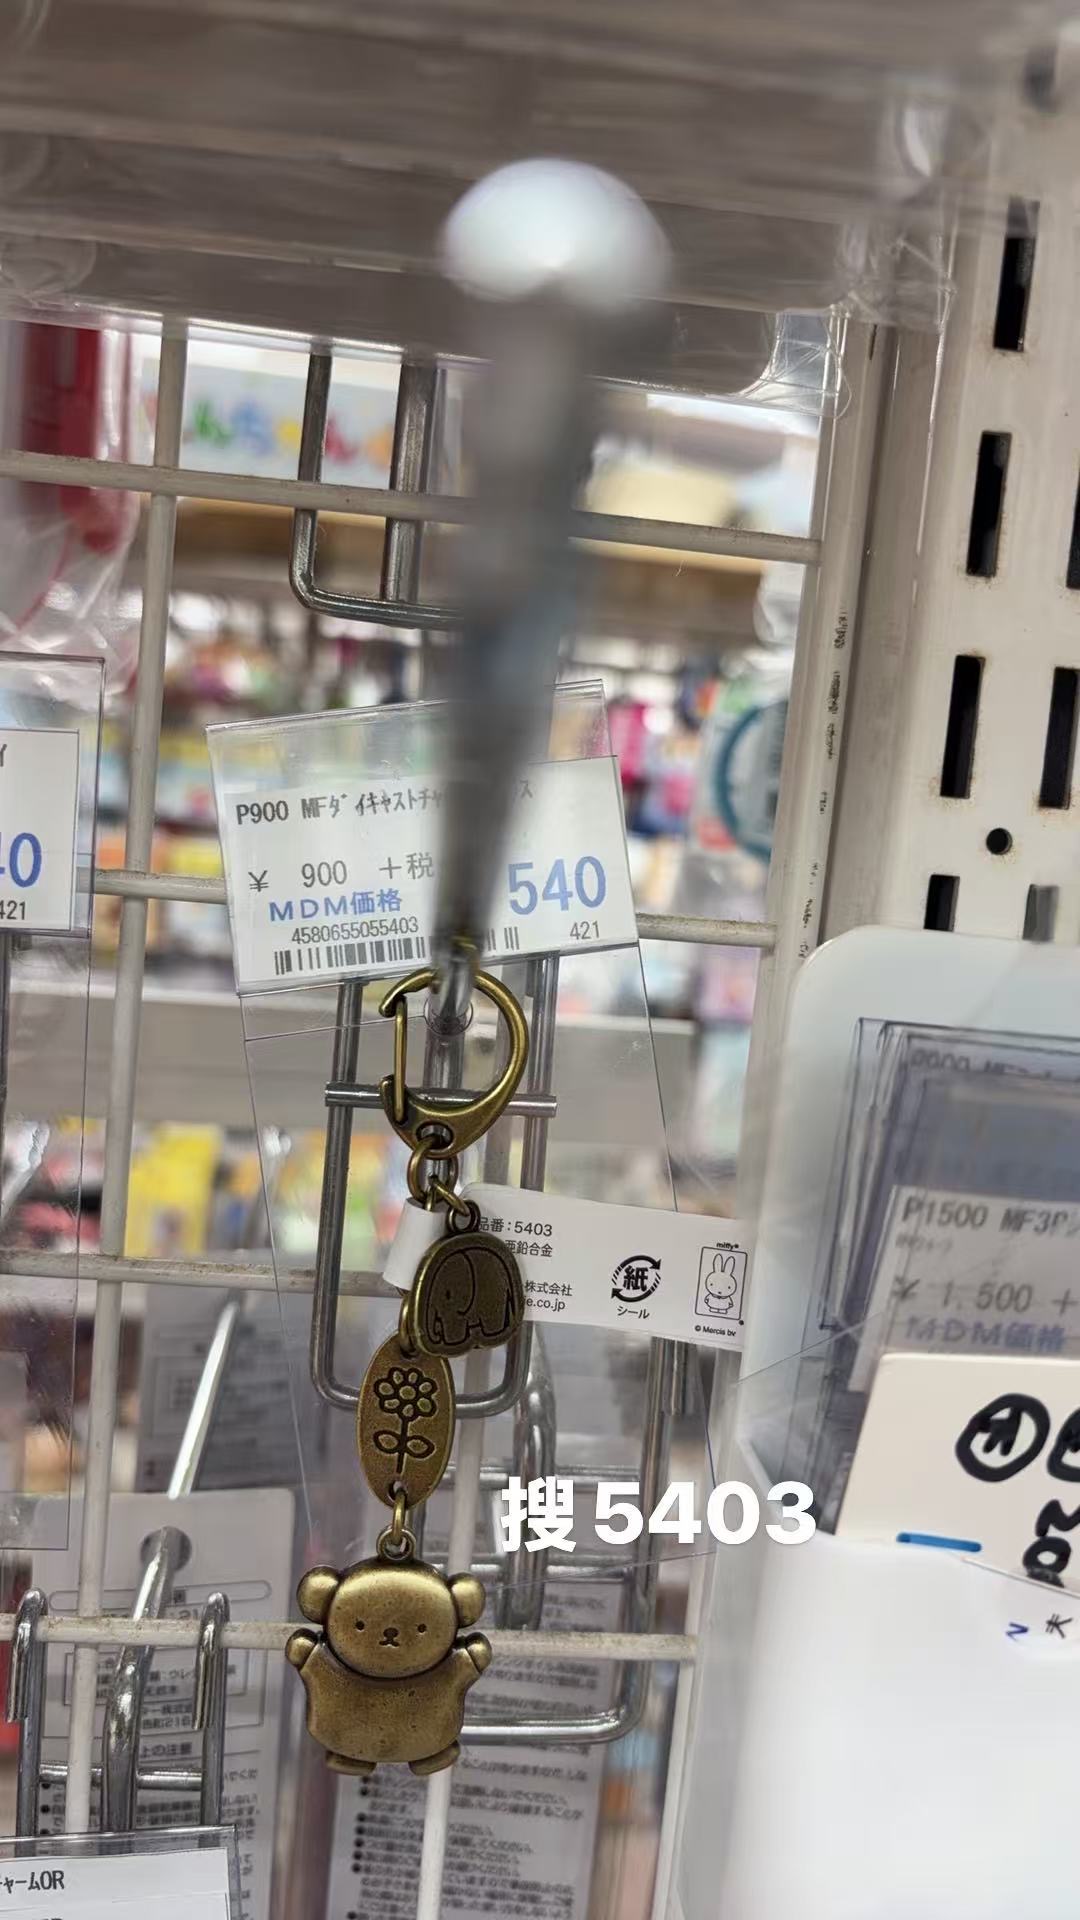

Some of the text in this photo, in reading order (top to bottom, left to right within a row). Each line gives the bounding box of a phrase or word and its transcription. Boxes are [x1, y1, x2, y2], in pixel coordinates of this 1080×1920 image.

[236, 799, 289, 825] P900
[0, 831, 42, 888] 0
[301, 860, 347, 888] 900
[508, 856, 606, 915] 540
[269, 888, 402, 922] MDM価格
[291, 916, 419, 944] 4580655055403
[570, 920, 600, 940] 421
[902, 1195, 989, 1230] P1500
[505, 1240, 553, 1257] 亜鉛合金
[525, 1280, 573, 1297] 株式会社
[622, 1265, 649, 1291] 紙
[525, 1297, 566, 1312] e.co.jp
[617, 1305, 650, 1319] シール
[0, 1870, 65, 1894] ャームOR
